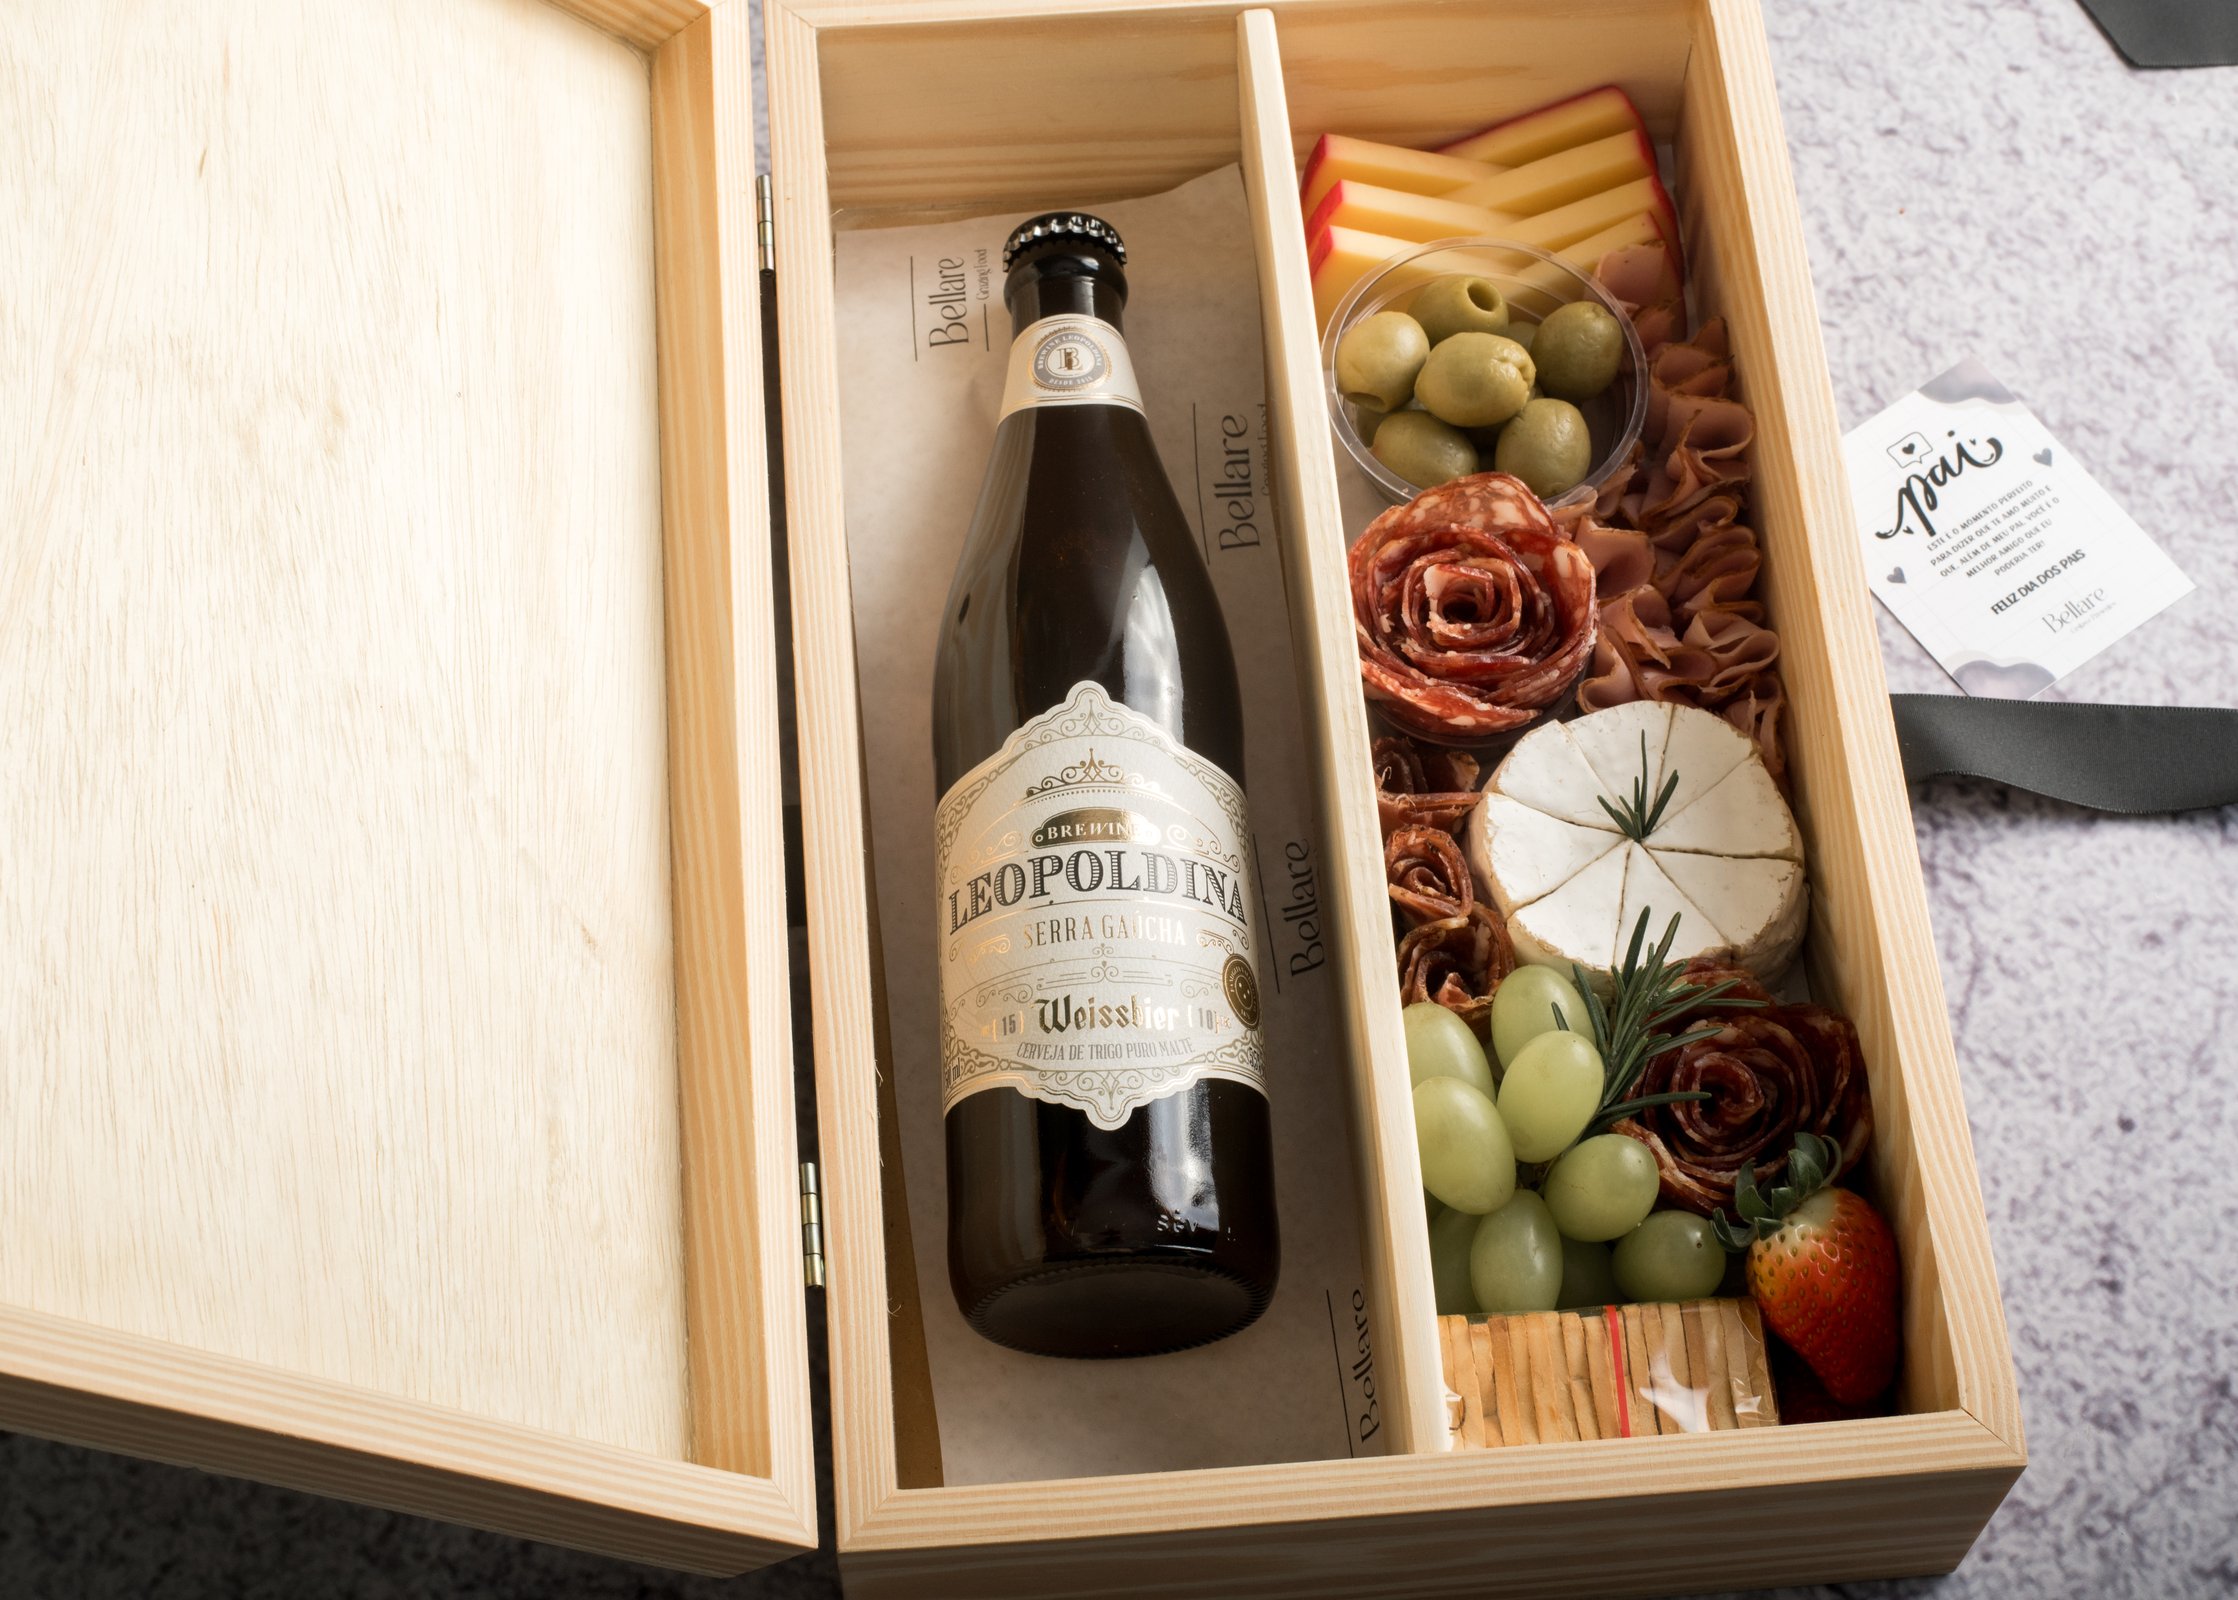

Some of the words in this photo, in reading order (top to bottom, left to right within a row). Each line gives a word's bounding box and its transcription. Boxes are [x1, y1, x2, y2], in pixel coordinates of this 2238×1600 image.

[928, 256, 969, 348] Bellare
[1213, 414, 1260, 552] Bellare
[1875, 429, 2004, 540] pai
[1926, 536, 1946, 552] ESTE
[1951, 527, 1960, 535] O
[1959, 503, 1998, 530] MOMENTO
[1997, 480, 2033, 505] PERFEITO
[1930, 550, 1953, 567] PARA
[1951, 534, 1975, 553] DIZER
[1974, 524, 1991, 537] QUE
[1991, 517, 2001, 526] TE
[2001, 505, 2020, 519] AMO
[2019, 489, 2046, 508] MUITO
[1965, 554, 1998, 578] MELHOR
[1998, 537, 2025, 556] AMIGO
[2024, 526, 2041, 539] QUE
[2040, 518, 2052, 529] EU
[1979, 541, 1991, 552] DE
[1991, 531, 2008, 543] MEU
[2051, 496, 2060, 504] O
[1990, 592, 2020, 615] FELIZ
[2017, 580, 2040, 598] DIA
[2035, 564, 2062, 585] DOS
[2058, 549, 2086, 570] PAIS
[1993, 552, 2029, 577] PODERIA
[2041, 588, 2104, 634] Bellare
[949, 849, 1248, 936] LEOPOLDINA
[1281, 838, 1325, 976] Bellare
[1023, 915, 1094, 950] SERRA
[1101, 910, 1187, 946] GAÚCHA
[1030, 993, 1183, 1035] Weissbier
[1016, 1041, 1065, 1061] CERVEJA
[1069, 1042, 1084, 1061] DE
[1087, 1041, 1122, 1060] TRIGO
[1126, 1041, 1157, 1060] PURO
[1159, 1037, 1195, 1057] MALTE
[1351, 1283, 1380, 1444] Bellare
